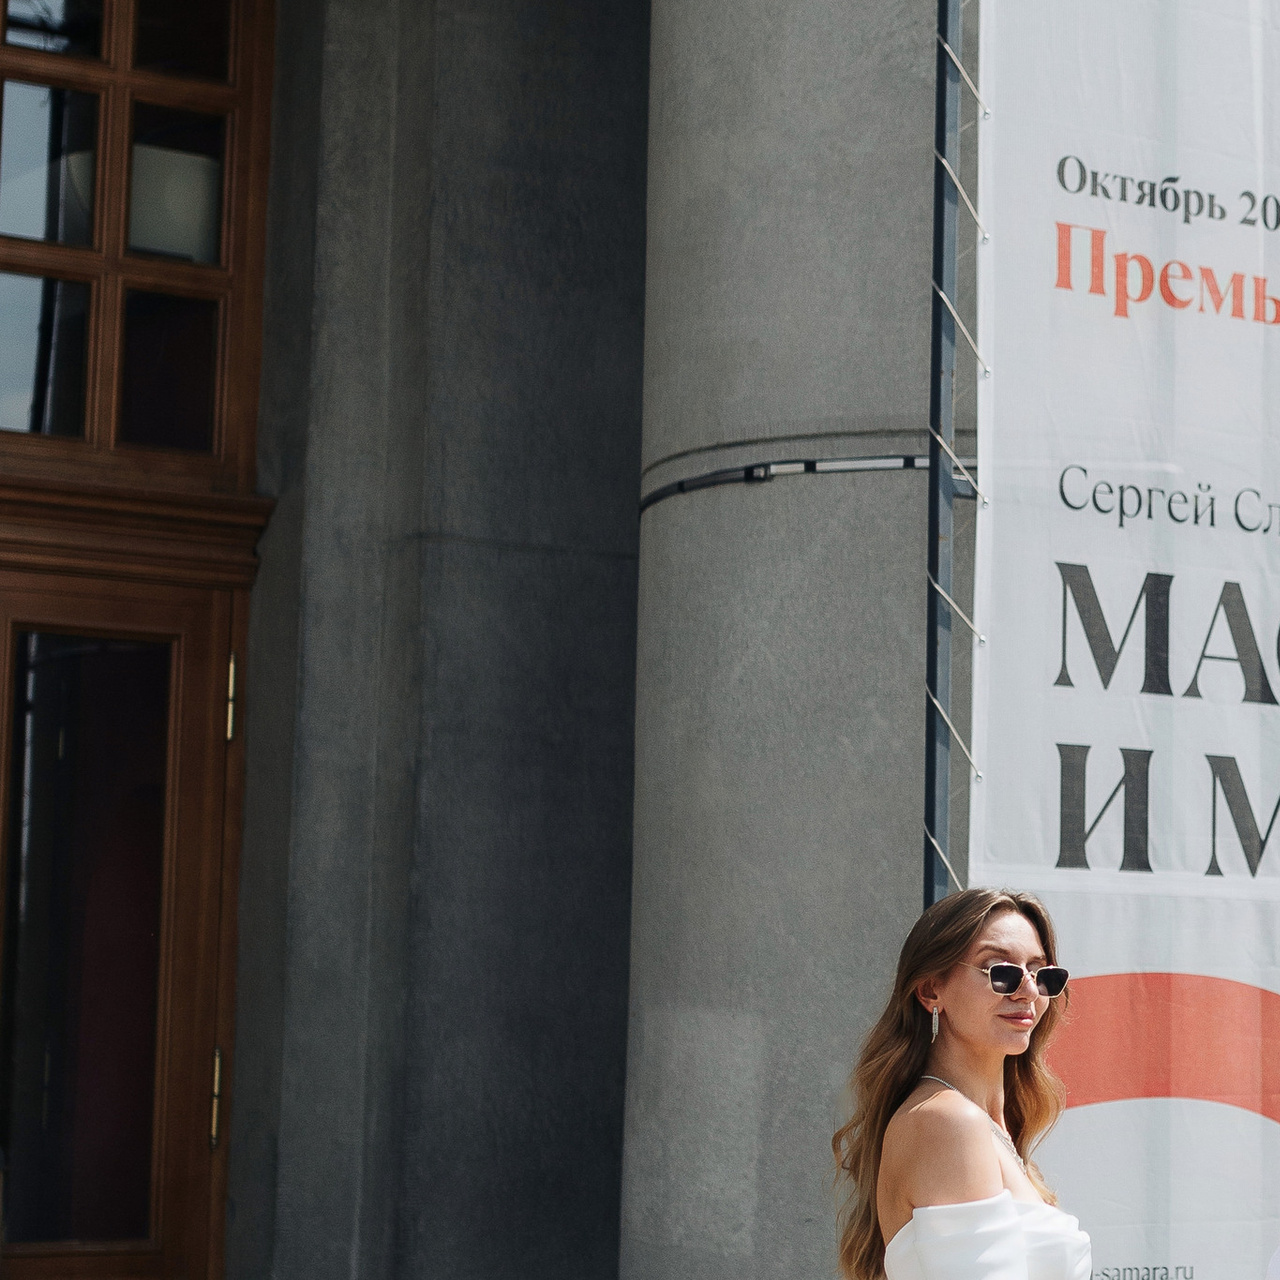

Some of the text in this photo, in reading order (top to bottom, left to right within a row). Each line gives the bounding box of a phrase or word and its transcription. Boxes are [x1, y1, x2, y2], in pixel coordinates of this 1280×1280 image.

[1056, 155, 1227, 223] Октябрь
[1059, 464, 1216, 527] Сергей
[1055, 743, 1154, 873] И
